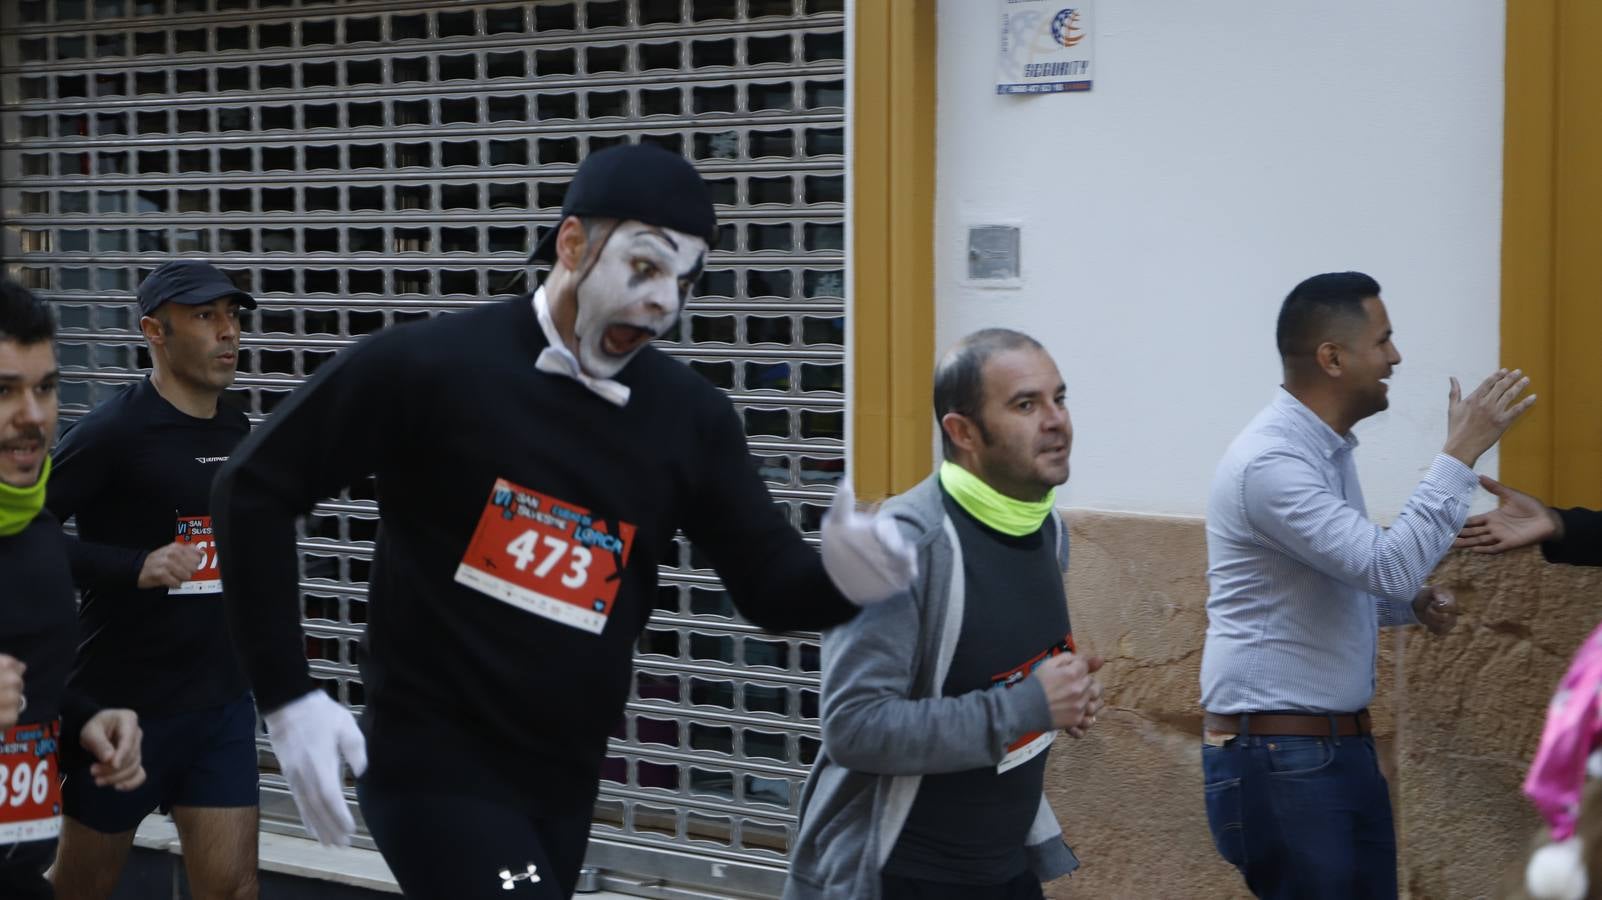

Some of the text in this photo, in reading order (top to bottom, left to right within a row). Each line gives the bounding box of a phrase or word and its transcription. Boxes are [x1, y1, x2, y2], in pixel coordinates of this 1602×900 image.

[1024, 60, 1089, 78] SECURITY
[516, 492, 540, 509] SAN
[177, 522, 187, 534] VI
[191, 527, 213, 535] SILVES
[574, 525, 623, 555] LORCA
[505, 529, 593, 589] 473
